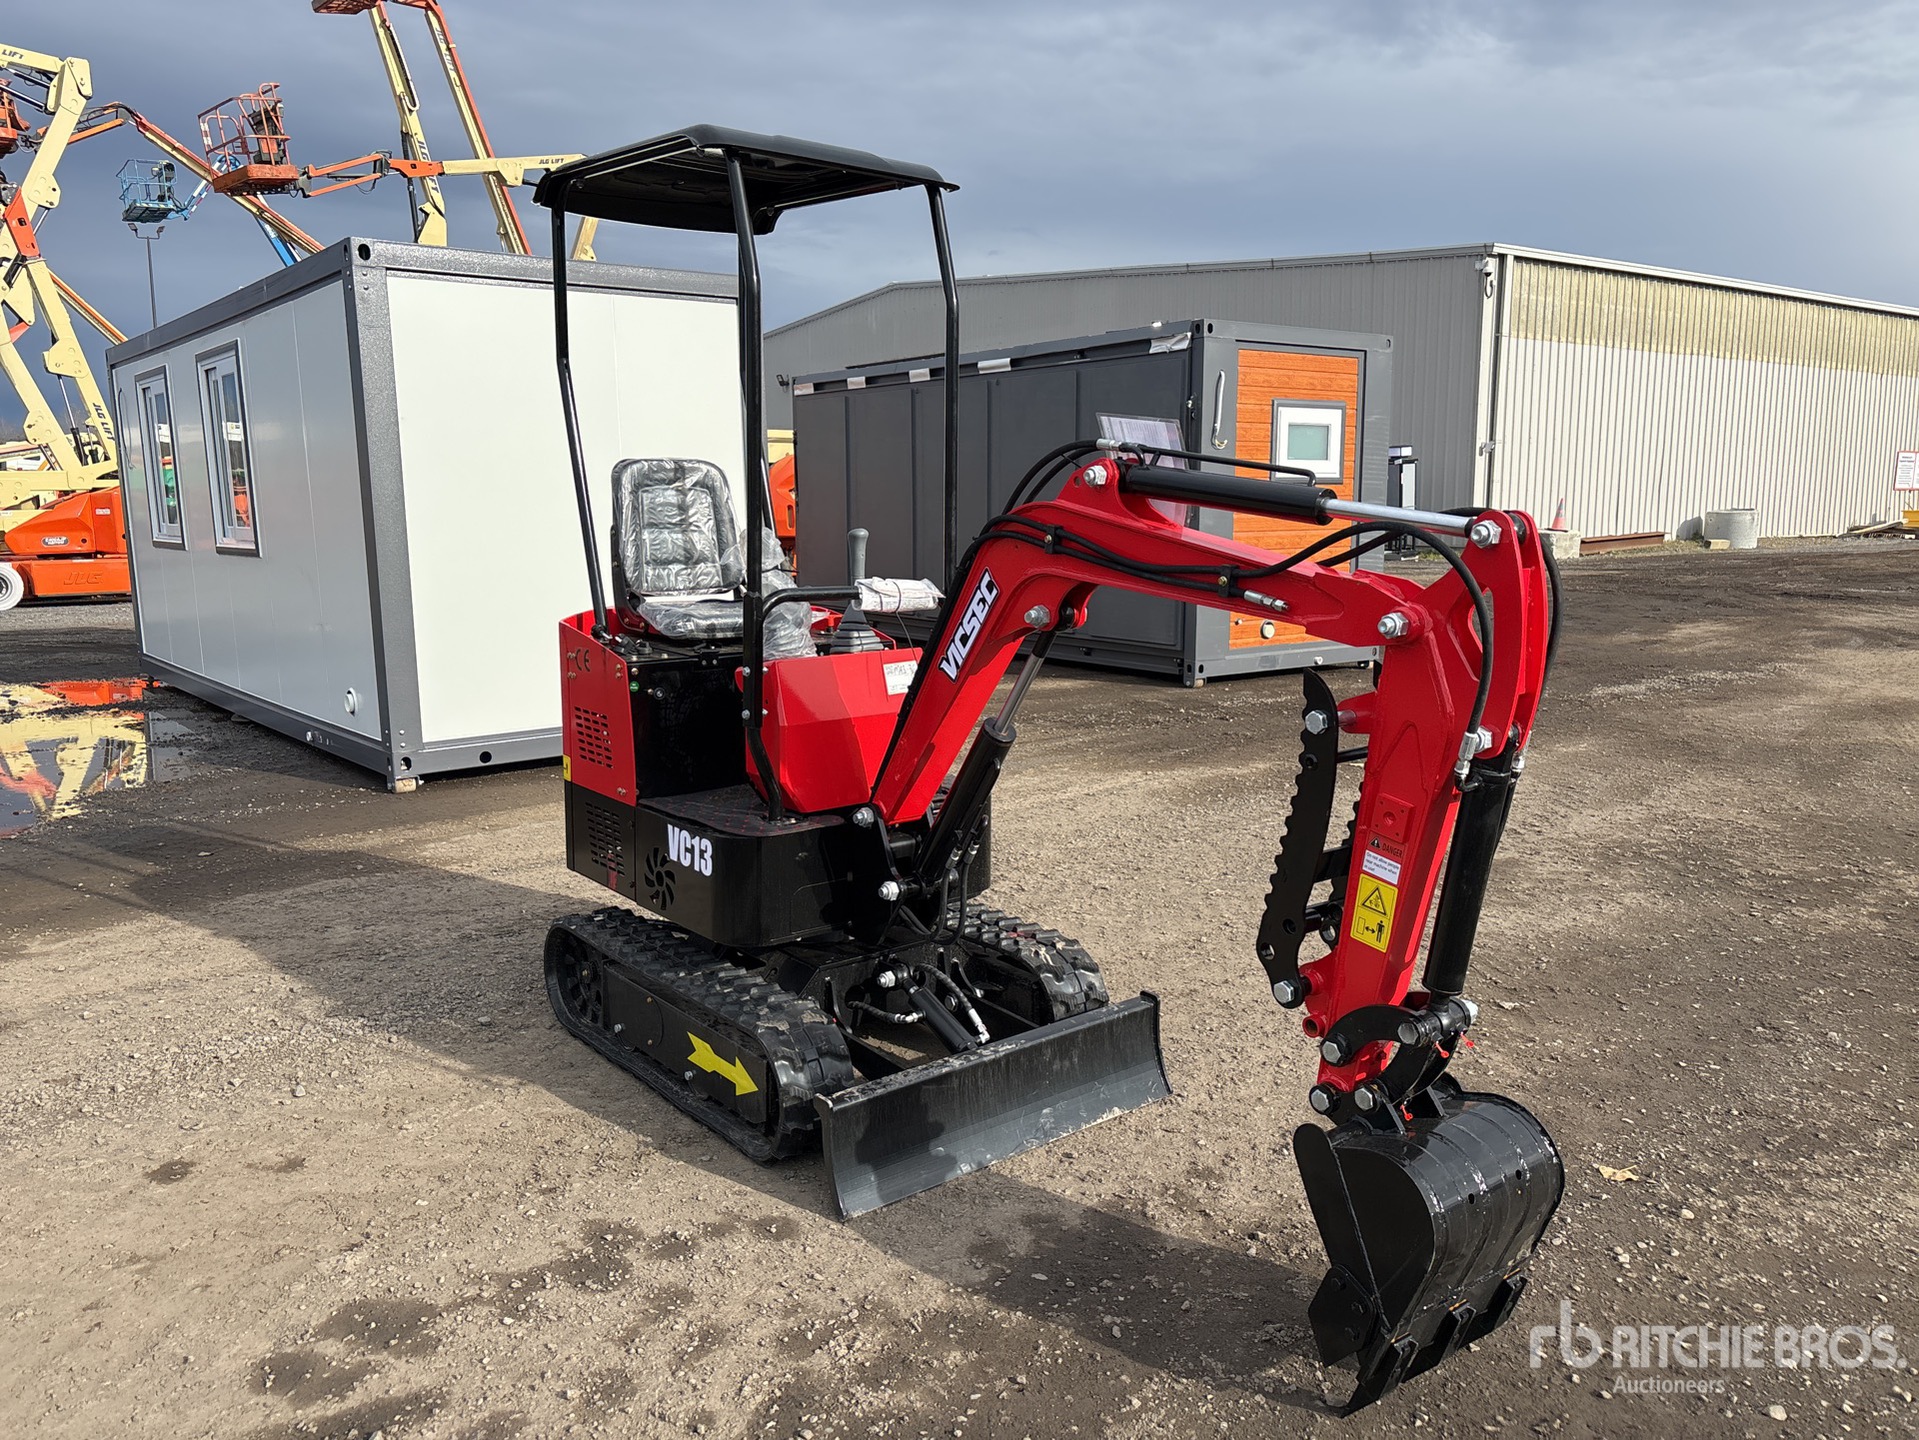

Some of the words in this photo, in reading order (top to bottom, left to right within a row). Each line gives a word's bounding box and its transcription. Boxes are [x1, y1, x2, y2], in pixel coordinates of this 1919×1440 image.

[1, 49, 24, 59] LIFT
[416, 138, 429, 160] JLG
[92, 402, 106, 419] JLG
[100, 421, 116, 441] LIFT
[63, 571, 104, 586] JLG
[940, 570, 998, 681] VICSEC
[667, 823, 713, 877] VC13
[1382, 843, 1402, 858] DANGER
[1373, 862, 1387, 870] machine
[1387, 861, 1399, 870] people
